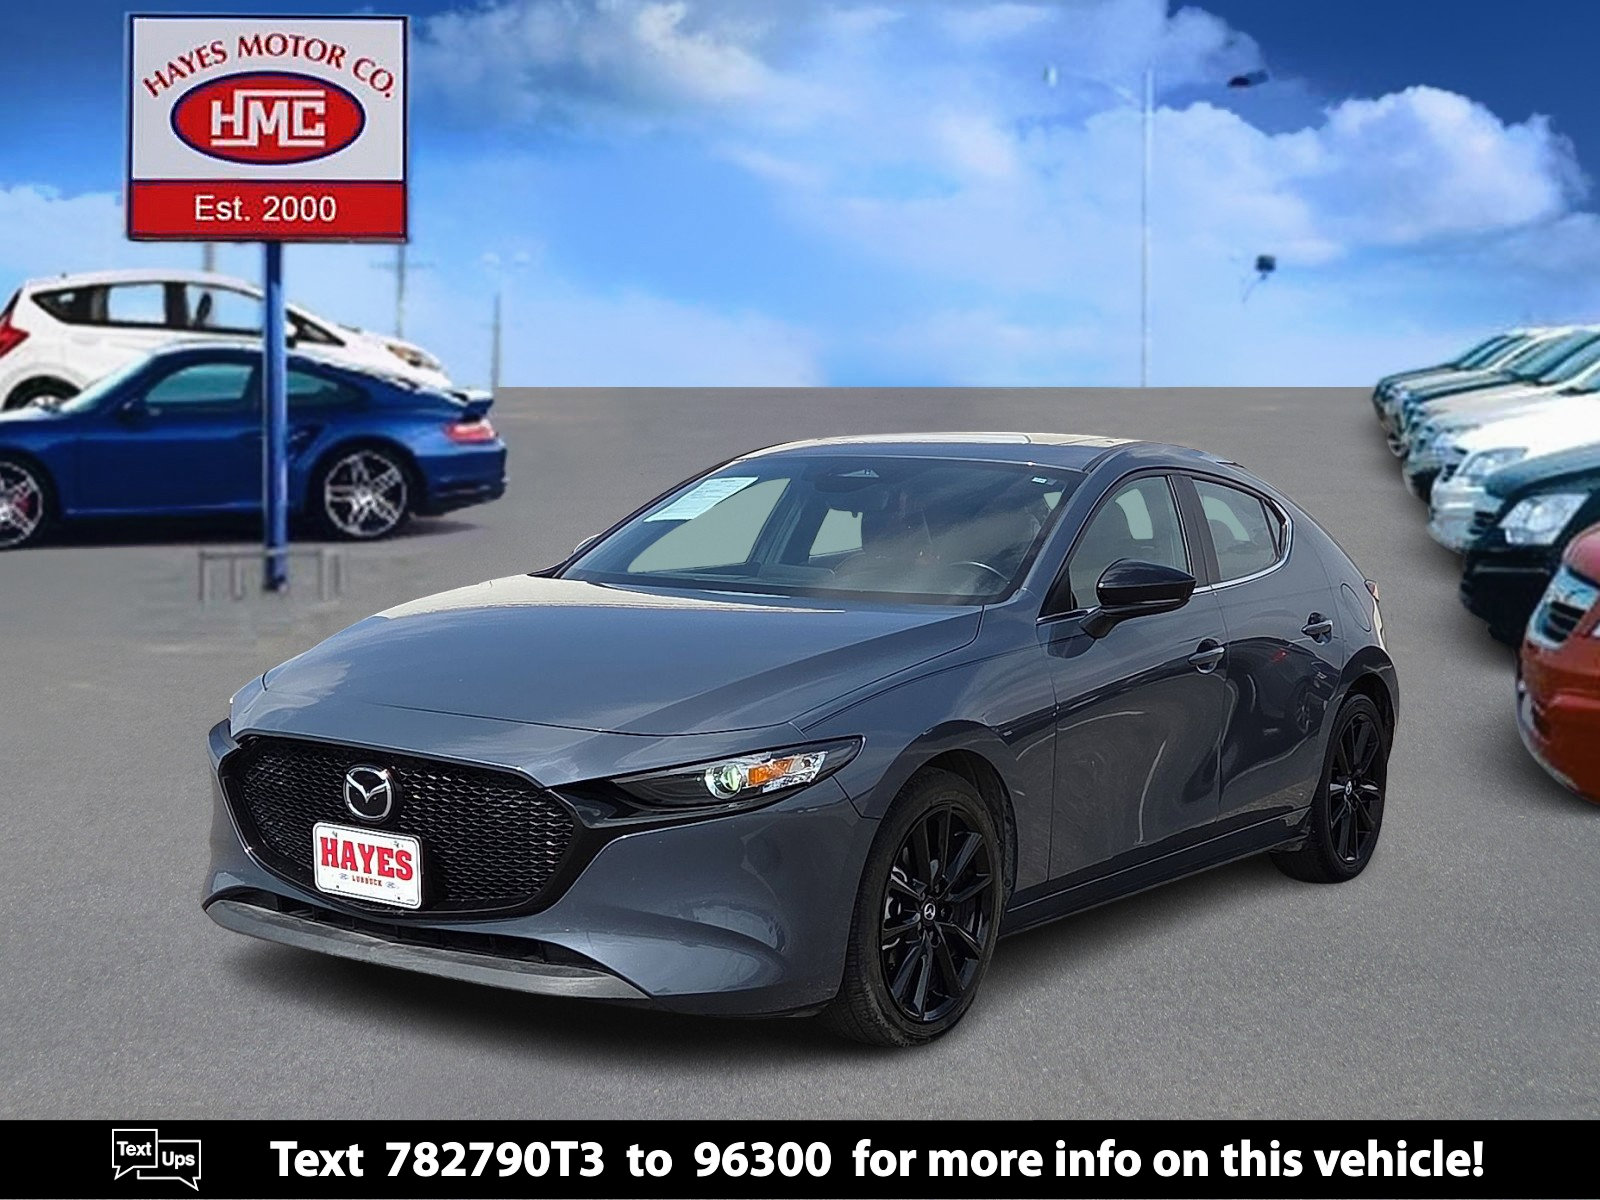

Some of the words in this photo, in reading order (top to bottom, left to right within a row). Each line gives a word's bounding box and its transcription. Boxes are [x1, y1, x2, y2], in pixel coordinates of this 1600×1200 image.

[142, 40, 228, 98] HAYES
[237, 32, 347, 70] MOTOR
[352, 57, 394, 98] CO.
[209, 88, 326, 148] HMC
[194, 194, 250, 222] Est.
[262, 194, 337, 222] 2000
[320, 836, 413, 881] HAYES
